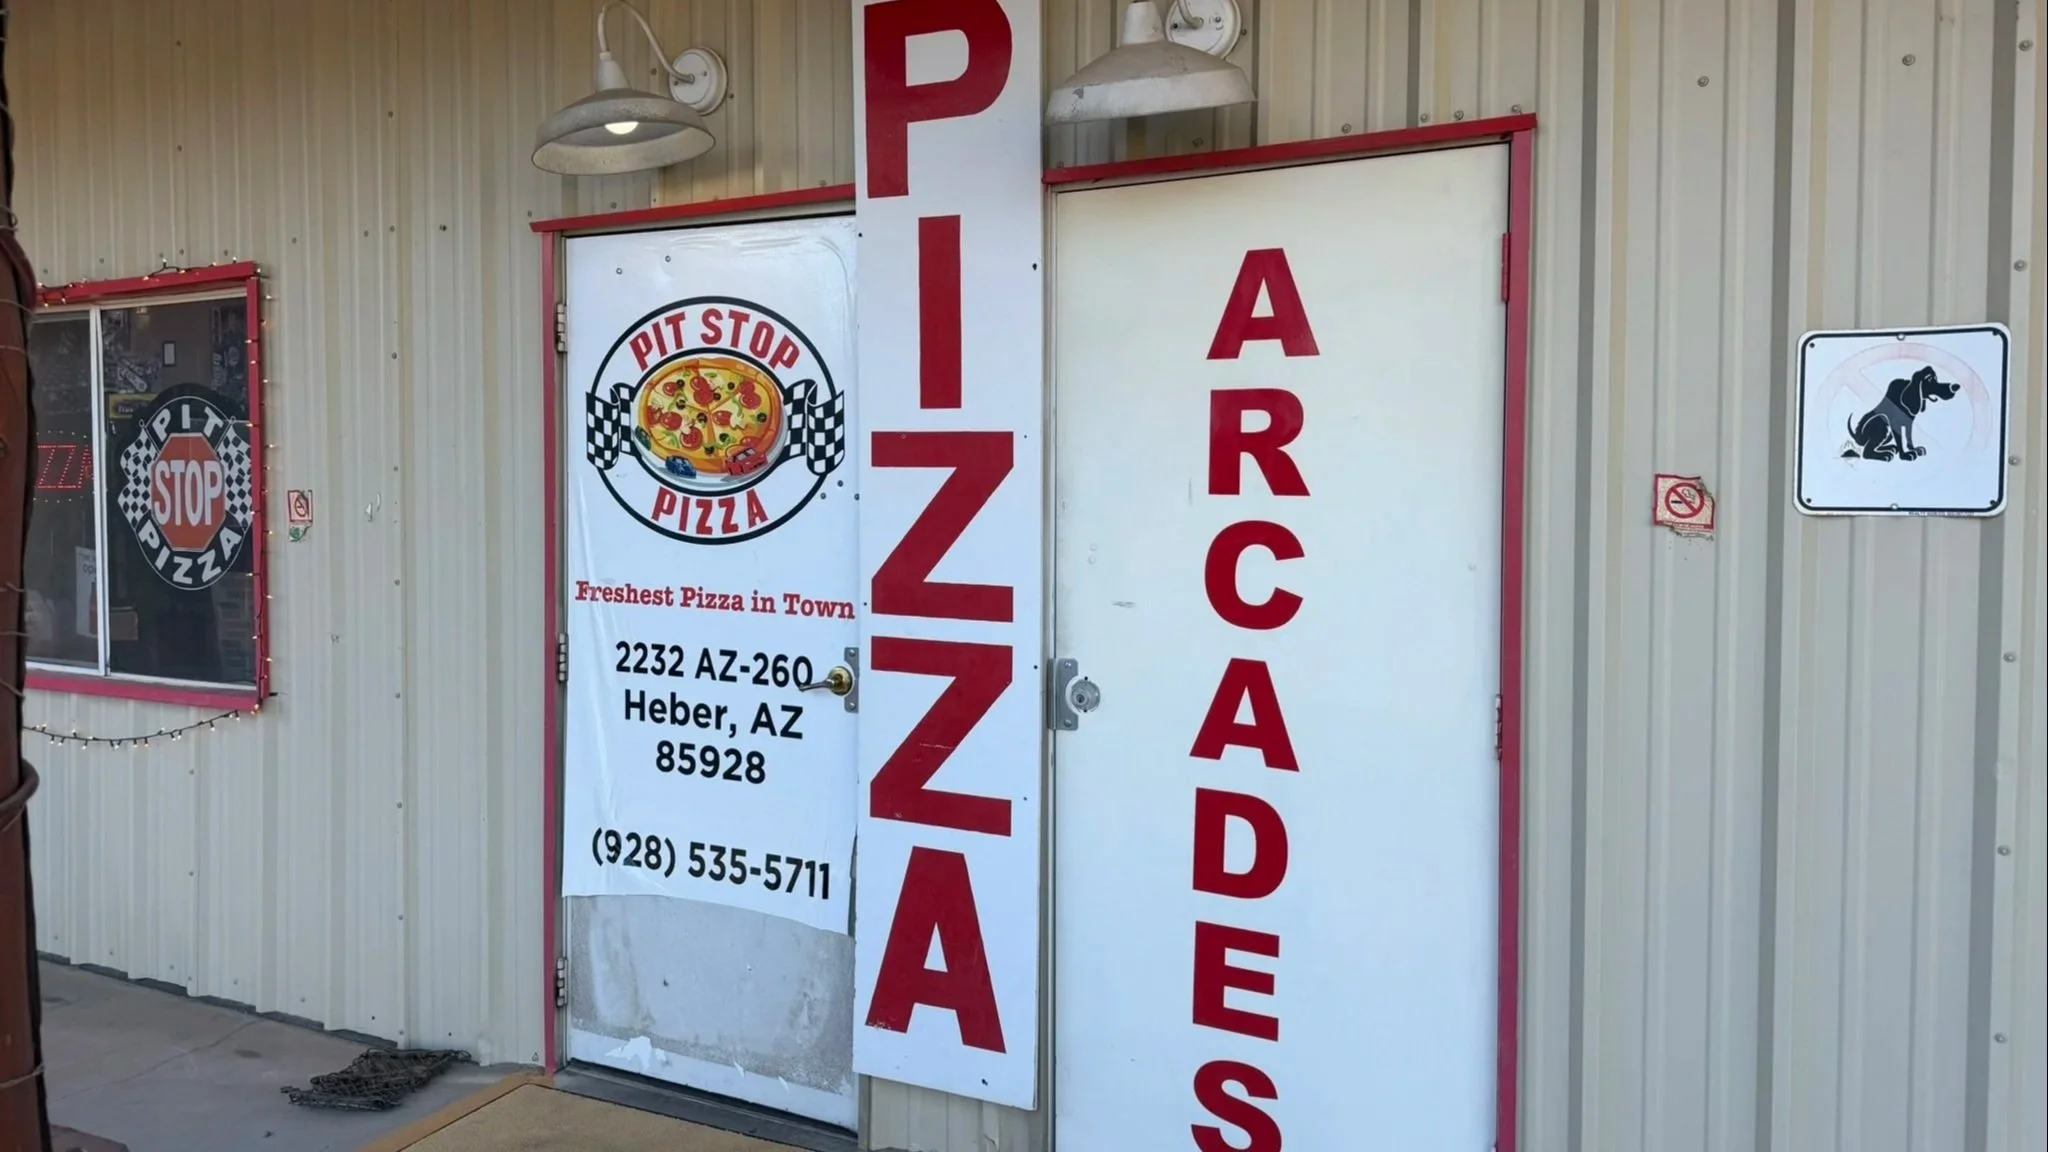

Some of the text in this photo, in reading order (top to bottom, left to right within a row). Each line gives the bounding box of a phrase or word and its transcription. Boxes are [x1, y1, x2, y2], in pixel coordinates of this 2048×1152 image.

[628, 307, 801, 373] PIT STOP
[151, 404, 224, 443] PIT
[154, 459, 223, 527] STOP
[650, 486, 769, 536] PIZZA
[138, 519, 243, 585] PIZZA
[863, 0, 1015, 1054] PIZZA
[575, 581, 856, 619] Freshest Pizza in Town
[615, 640, 814, 689] 2232 AZ-260
[624, 688, 804, 740] Heber, AZ
[1190, 247, 1320, 1152] ARCADES
[655, 740, 766, 785] 85928
[592, 827, 830, 900] (928) 535-5711
